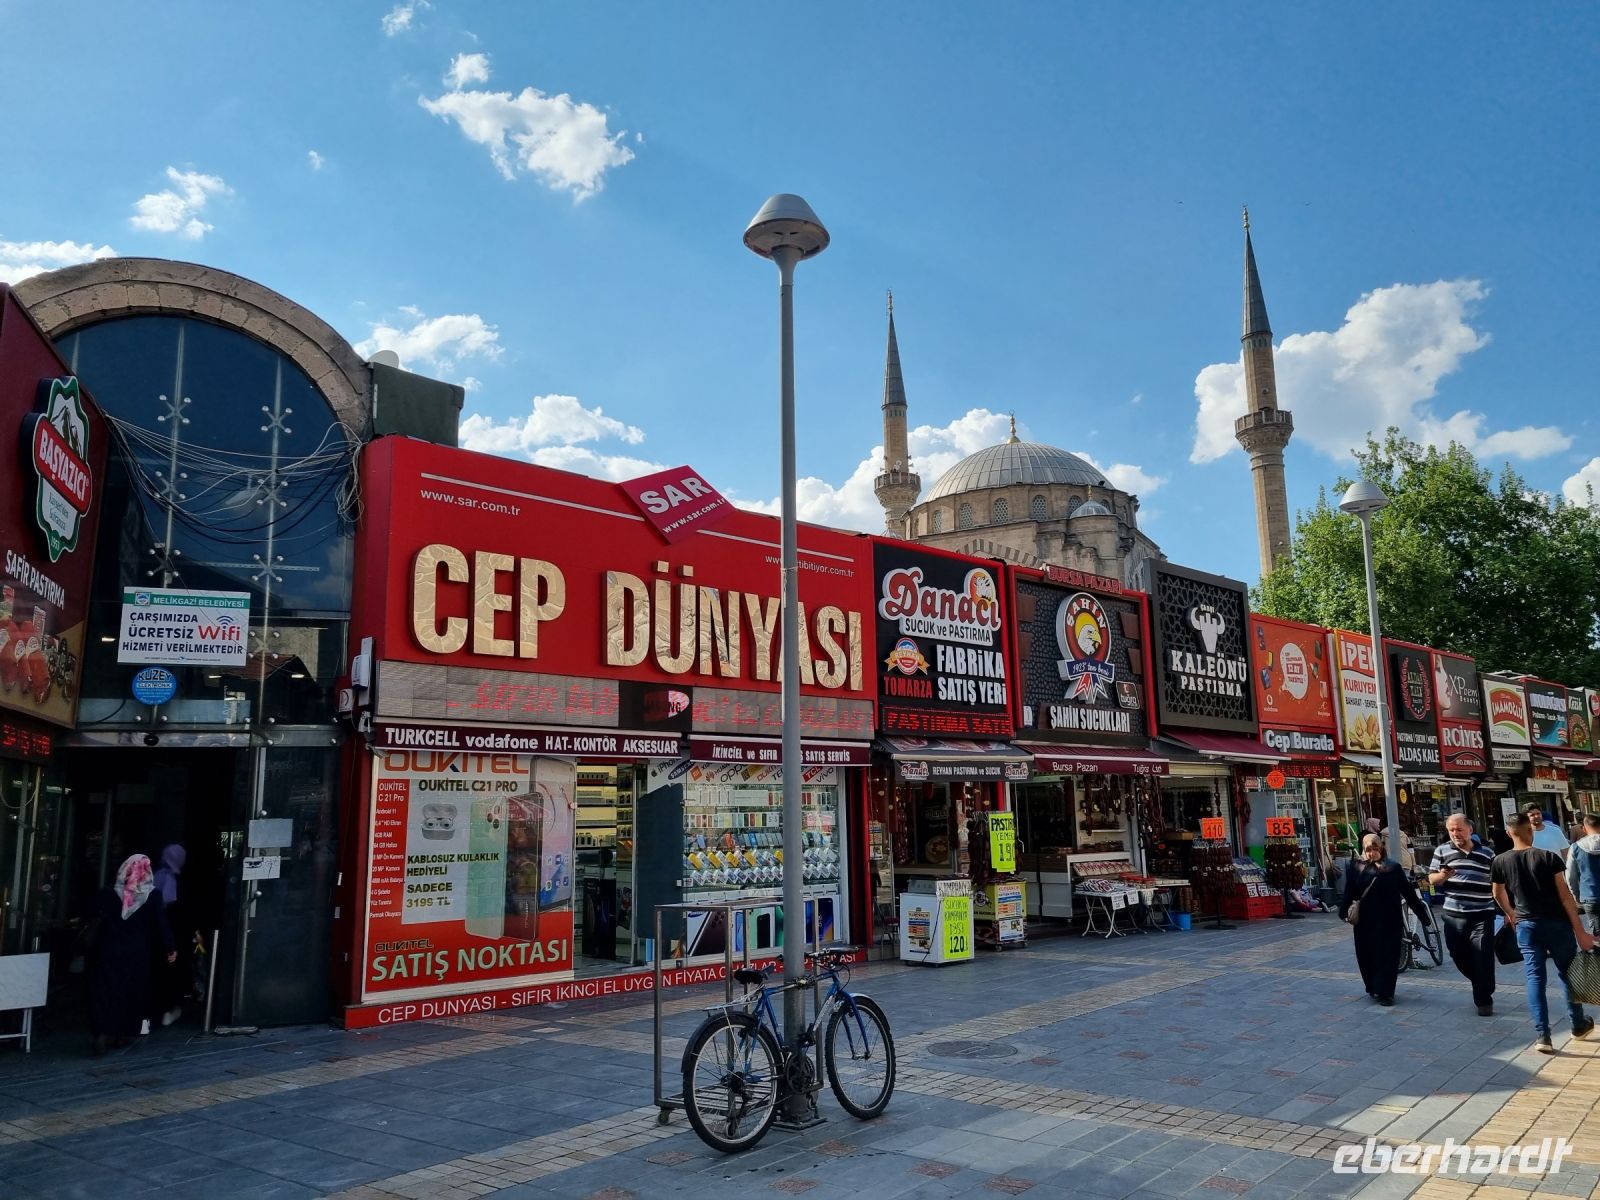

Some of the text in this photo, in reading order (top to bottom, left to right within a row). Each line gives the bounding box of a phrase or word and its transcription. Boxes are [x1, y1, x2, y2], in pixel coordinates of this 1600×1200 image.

[40, 429, 87, 502] BAŞYAZICI
[420, 489, 521, 516] www.sar.com.tr
[639, 477, 712, 514] SAR
[662, 498, 727, 534] www.sar.com.tr
[5, 550, 65, 611] SAFİR PASTIRMA
[1048, 566, 1123, 595] BURSA PAZARI
[153, 597, 244, 607] MELİKGAZİ BELEDİYESİ
[885, 570, 999, 628] Danacı
[129, 612, 198, 624] ÇARŞIMIZDA
[412, 544, 864, 692] CEP DÜNYASI
[1067, 598, 1107, 629] ŞAHİN
[128, 624, 241, 640] ÜCRETSİZ Wifi
[905, 618, 991, 643] SUCUK ve PASTIRMA
[122, 640, 243, 654] HİZMETİ VERİLMEKTEDİR
[1171, 649, 1247, 682] KALEÖNÜ
[138, 669, 171, 681] KUZEY
[884, 676, 933, 698] TOMARZA
[937, 676, 977, 705] SATIŞ
[1180, 675, 1242, 697] PASTIRMA
[1343, 678, 1377, 695] KURUYEM
[1050, 705, 1131, 733] ŞAHİN SUCUKLARI
[1492, 702, 1523, 720] İMAMOĞLU
[887, 712, 971, 732] PASTIRMA
[385, 727, 678, 754] TURKCELL vodafone HAT-KONTÖR AKSESUAR
[1265, 730, 1335, 752] Cep Burada
[384, 751, 529, 775] OUKITEL
[747, 750, 755, 760] ve
[759, 749, 778, 760] SIFIR
[805, 750, 825, 763] SATIŞ
[827, 750, 851, 762] SERVİS
[1399, 747, 1421, 765] ALDAŞ
[1422, 748, 1440, 763] KALE
[805, 766, 823, 779] TCL
[816, 767, 834, 783] vivo
[932, 766, 952, 776] REYHAN
[985, 767, 1001, 776] SUCUK
[1052, 761, 1073, 772] Bursa
[379, 780, 407, 791] OUKİTEL
[418, 778, 518, 792] OUKİTEL C21 PRO
[378, 794, 404, 802] C 21 Pro
[1272, 822, 1291, 836] 85
[407, 852, 499, 864] KABLOSUZ KULAKLIK
[406, 865, 448, 877] HEDİYELİ
[407, 882, 452, 893] SADECE
[406, 897, 451, 908] 3199 TL
[375, 939, 434, 952] OUKITEL
[371, 939, 567, 981] SATIŞ NOKTASI
[378, 1006, 416, 1024] CEP
[421, 996, 497, 1019] DUNYASI
[511, 989, 552, 1006] SIFIR
[556, 981, 600, 1000] İKİNCİ
[603, 980, 621, 993] EL
[624, 974, 672, 991] UYGN
[675, 967, 717, 985] FİYATA
